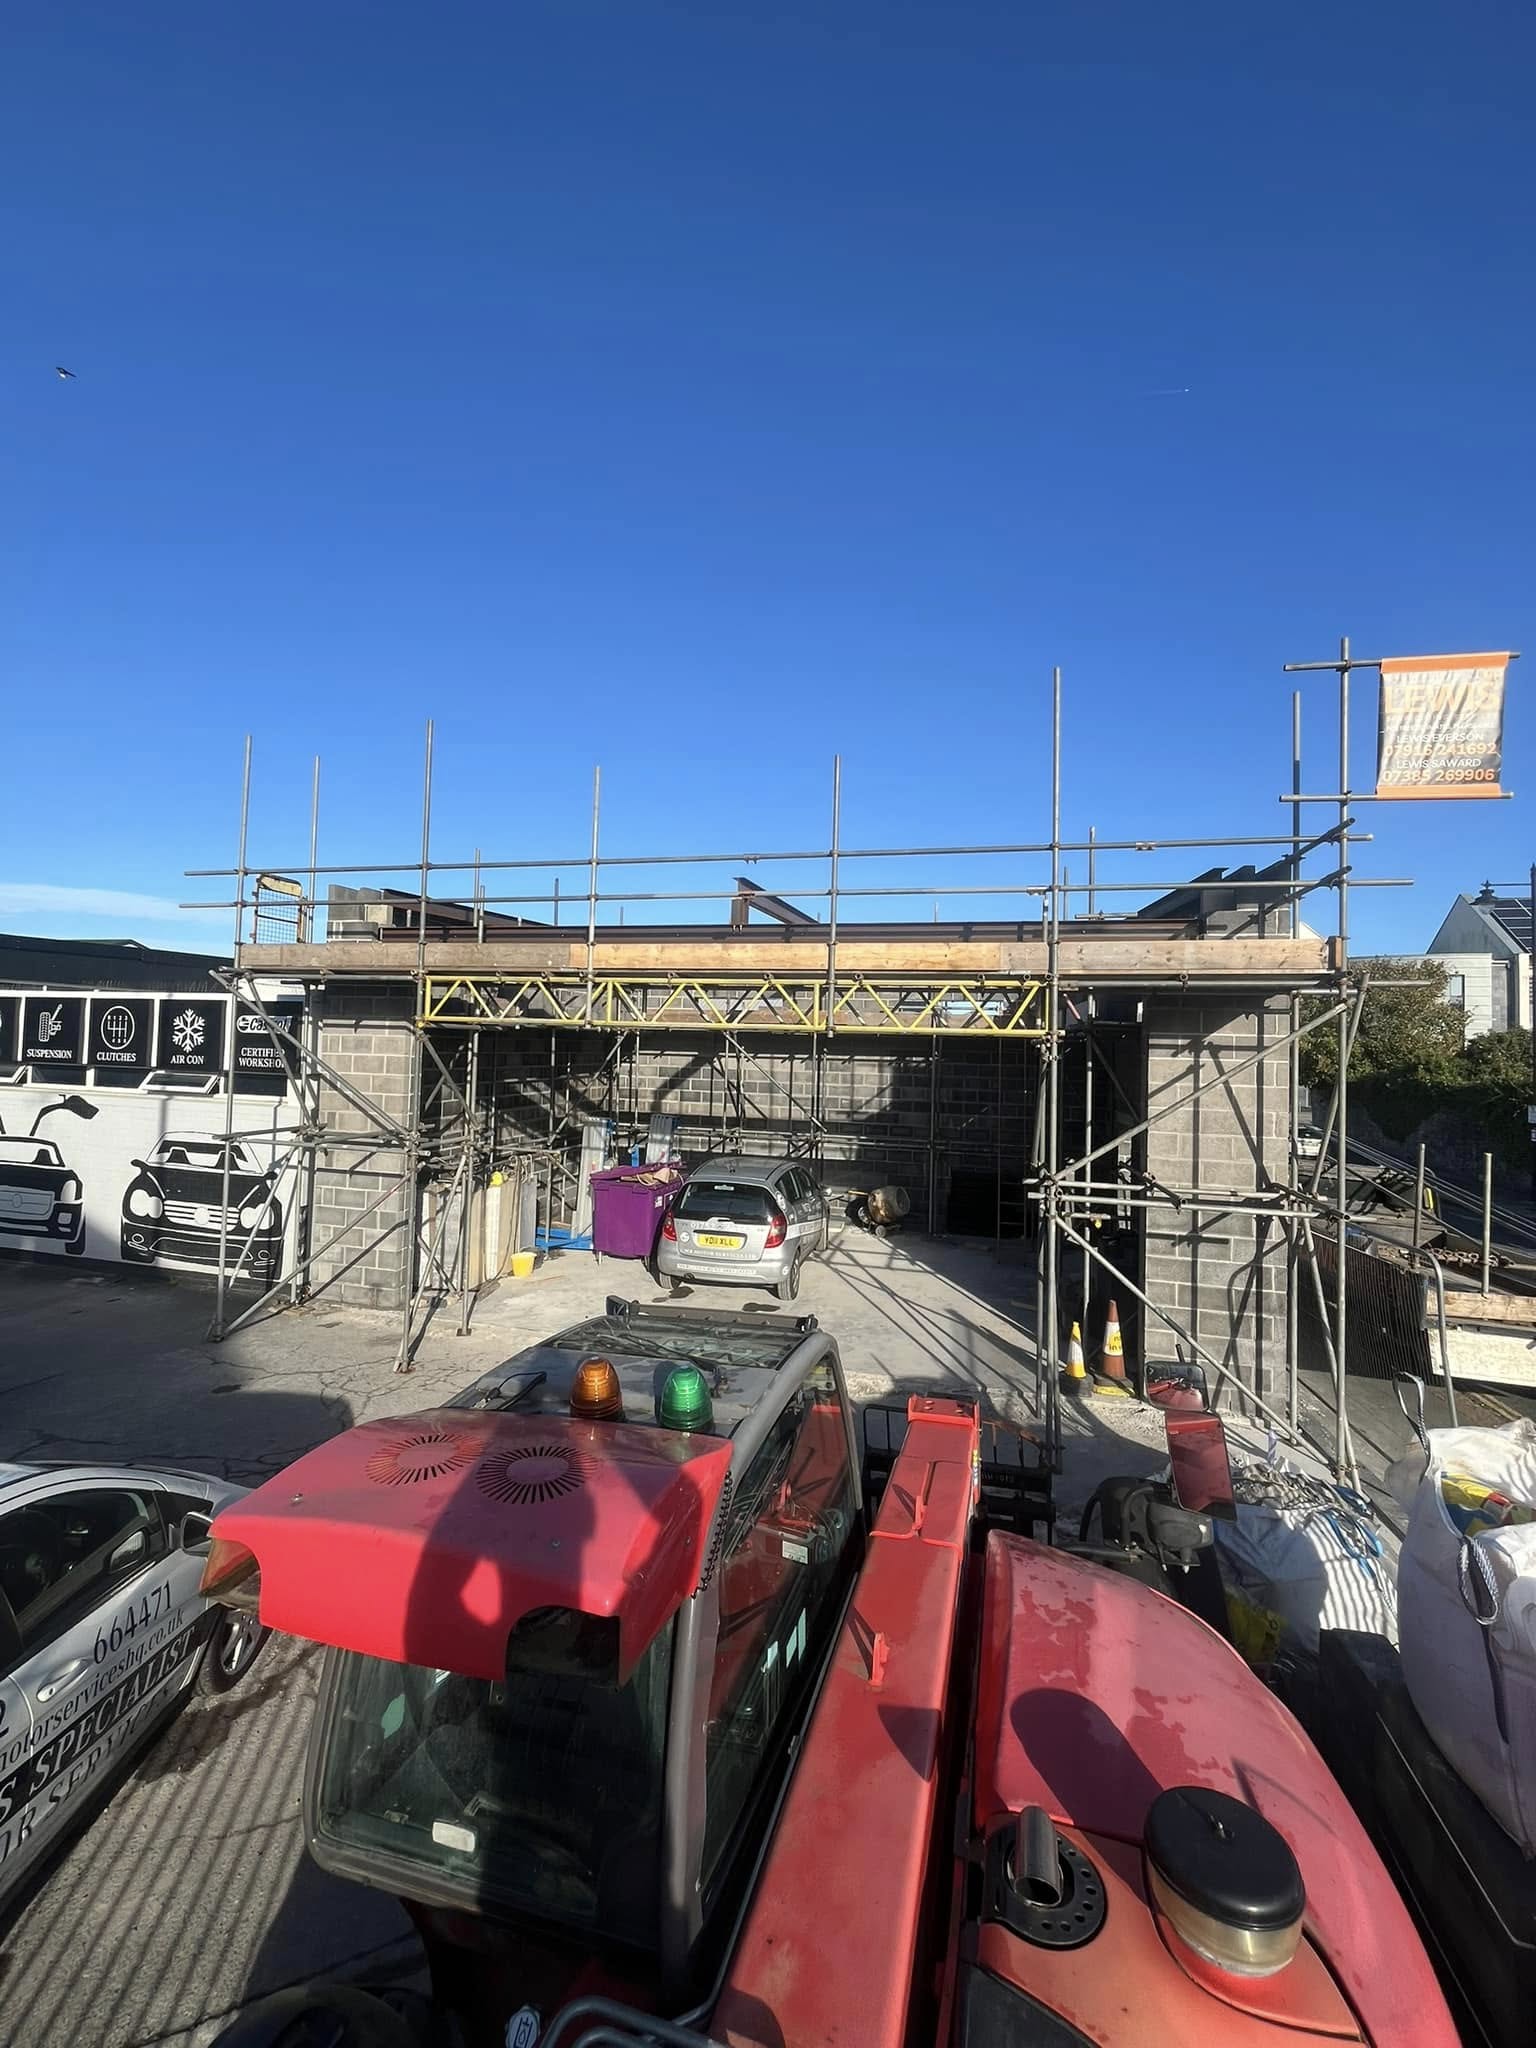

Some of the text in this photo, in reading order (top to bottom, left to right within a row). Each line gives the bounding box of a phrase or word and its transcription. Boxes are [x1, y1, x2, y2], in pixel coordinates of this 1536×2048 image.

[1385, 682, 1499, 713] LEWIS
[1438, 742, 1497, 756] 241692
[1397, 758, 1482, 769] LEWIS SAWARD
[1383, 768, 1495, 782] 07385 269906
[26, 1048, 73, 1060] SUSPENSION
[96, 1051, 137, 1062] CLUTCHES
[170, 1054, 204, 1065] AIR CON
[93, 1580, 173, 1665] 664471
[29, 1625, 196, 1798] SPECIALIST
